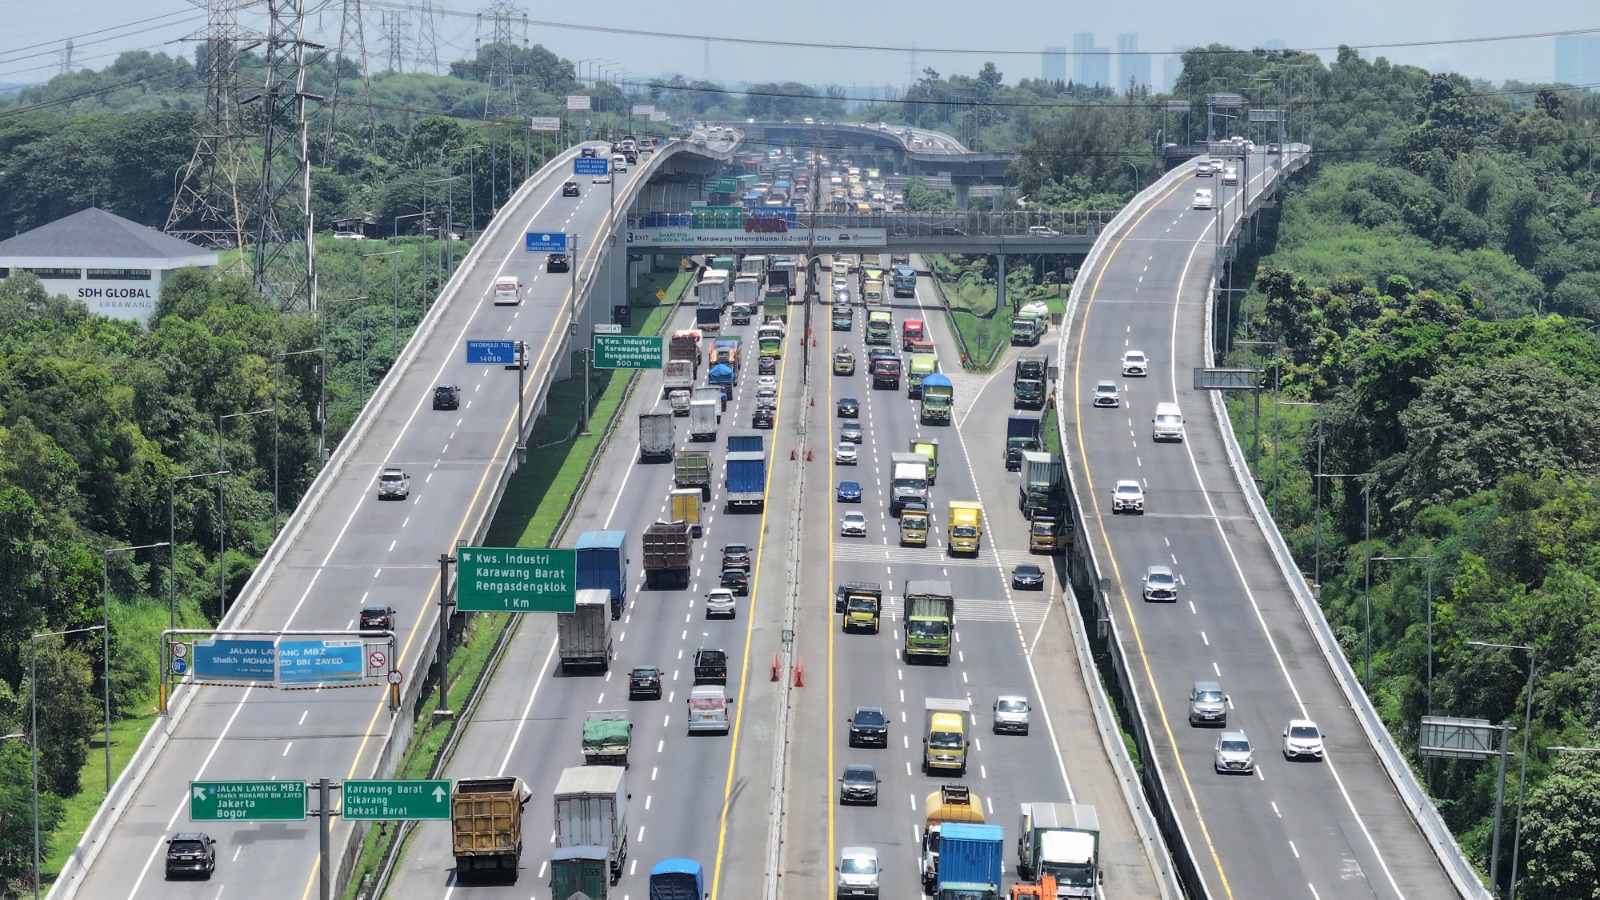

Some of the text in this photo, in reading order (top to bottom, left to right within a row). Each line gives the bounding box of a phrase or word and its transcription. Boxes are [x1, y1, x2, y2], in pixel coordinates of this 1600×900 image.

[78, 288, 151, 298] SDH GLOBAL
[99, 301, 152, 309] KARAWANG
[605, 346, 639, 354] Karawang
[605, 353, 661, 361] Rengasdengklok
[476, 553, 549, 565] Kws. Industri
[476, 568, 565, 580] Karawang Barat
[476, 581, 566, 594] Rengasdengklok
[504, 598, 529, 608] 1 Km
[229, 647, 257, 655] JALAN
[304, 648, 326, 656] MBZ
[216, 785, 242, 793] JALAN
[280, 784, 301, 792] MBZ
[347, 785, 423, 796] Karawang Barat
[217, 800, 255, 808] Jakarta
[347, 796, 388, 806] Cikarang
[217, 810, 247, 819] Bogor
[347, 807, 408, 815] Bekasi Barat
